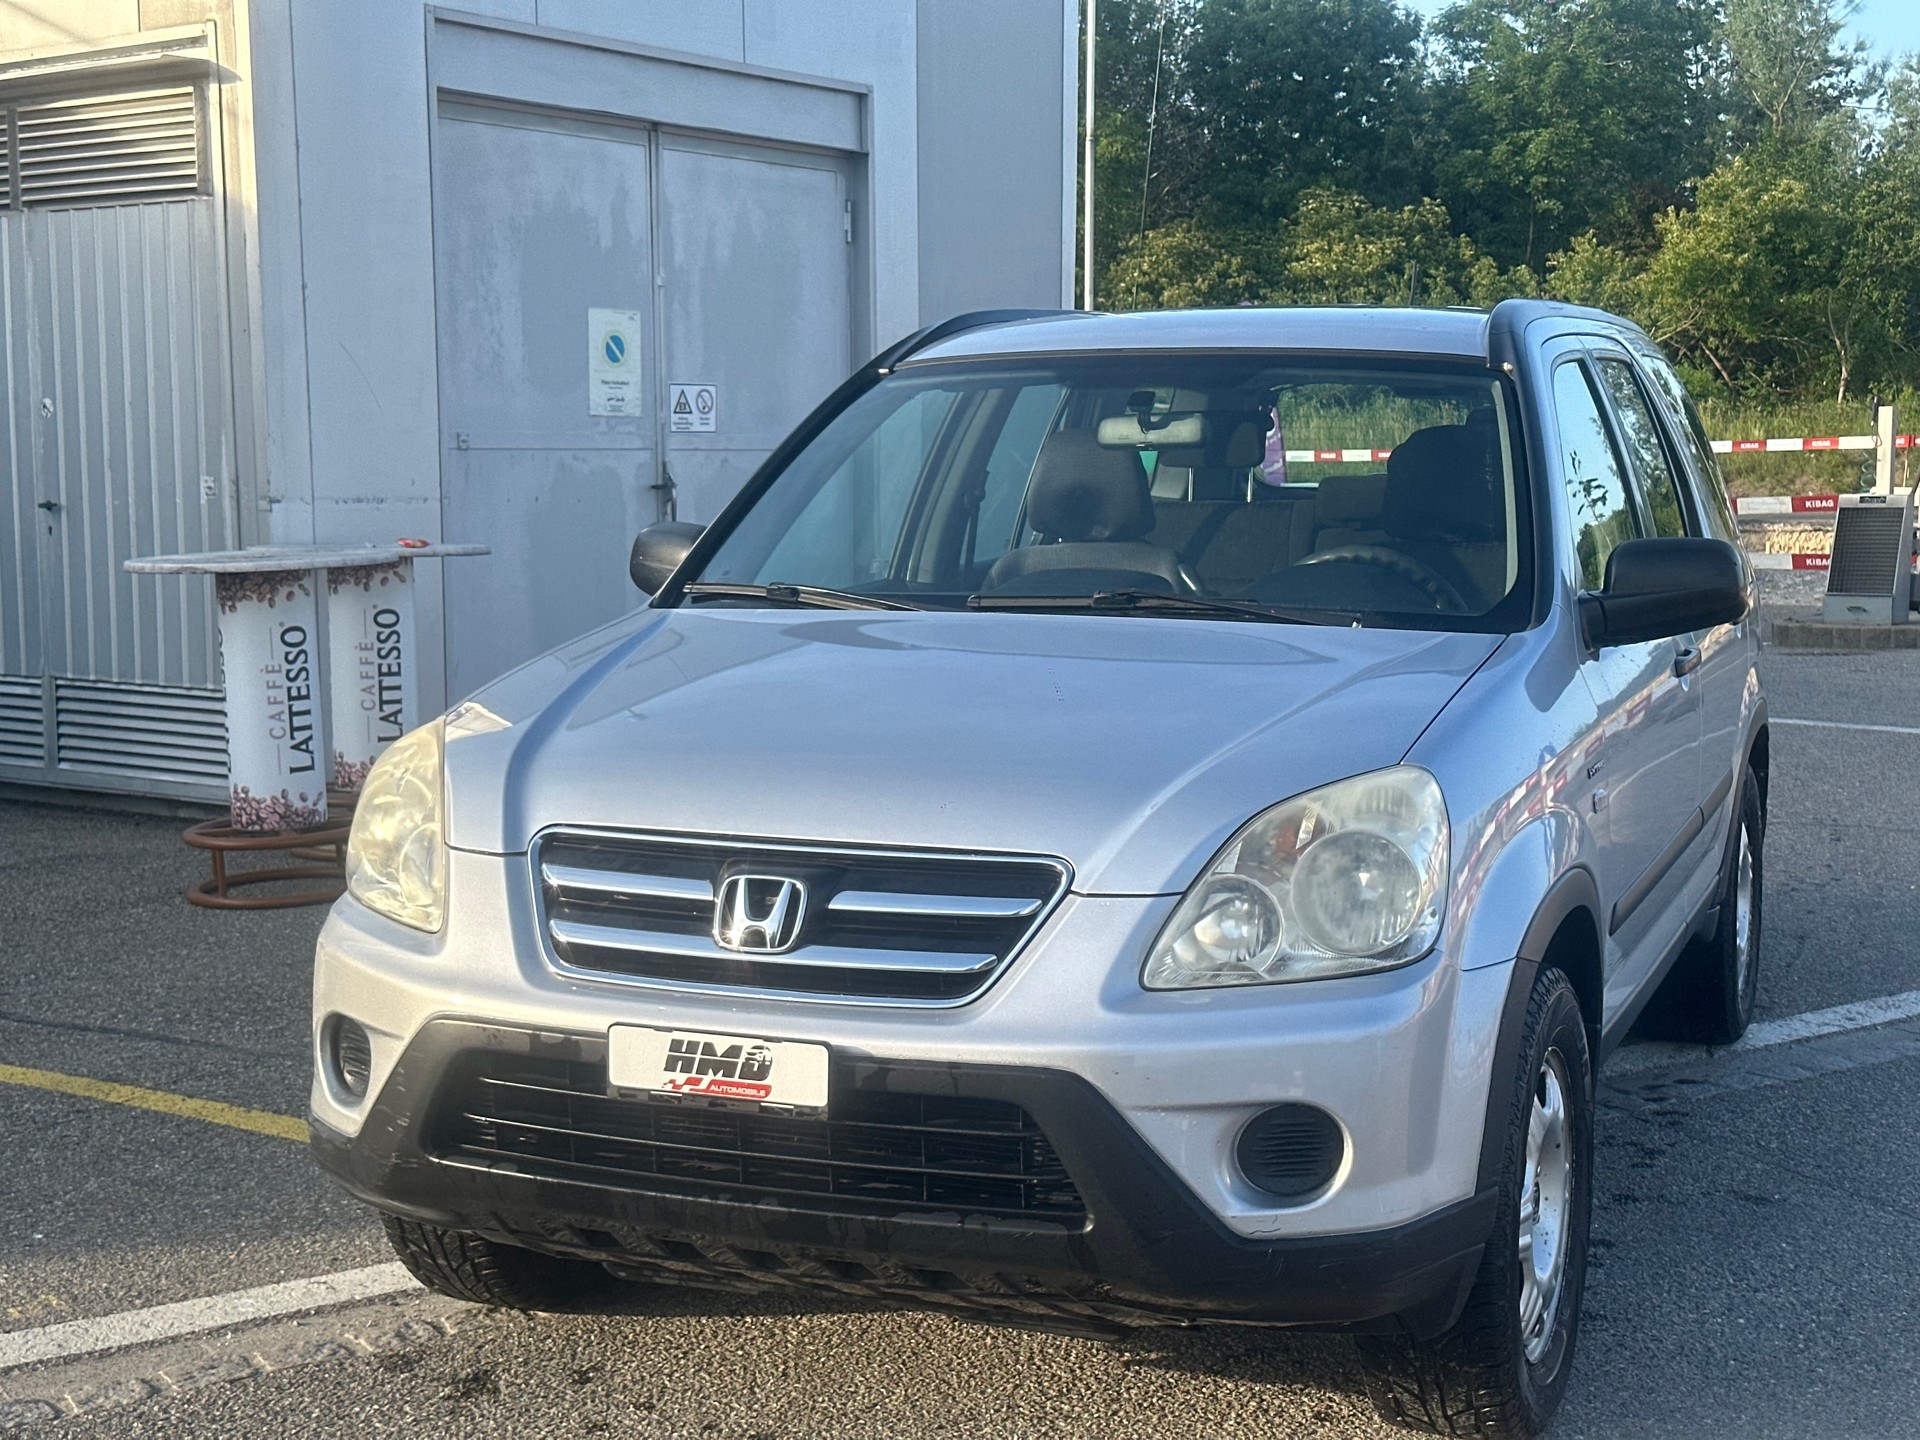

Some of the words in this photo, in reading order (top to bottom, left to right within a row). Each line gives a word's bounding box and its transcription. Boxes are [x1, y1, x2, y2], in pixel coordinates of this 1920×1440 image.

[1805, 499, 1834, 508] KIBAG
[279, 625, 315, 775] LATTESSO
[373, 608, 403, 743] LATTESSO
[709, 1084, 766, 1096] AUTOMOBILE
